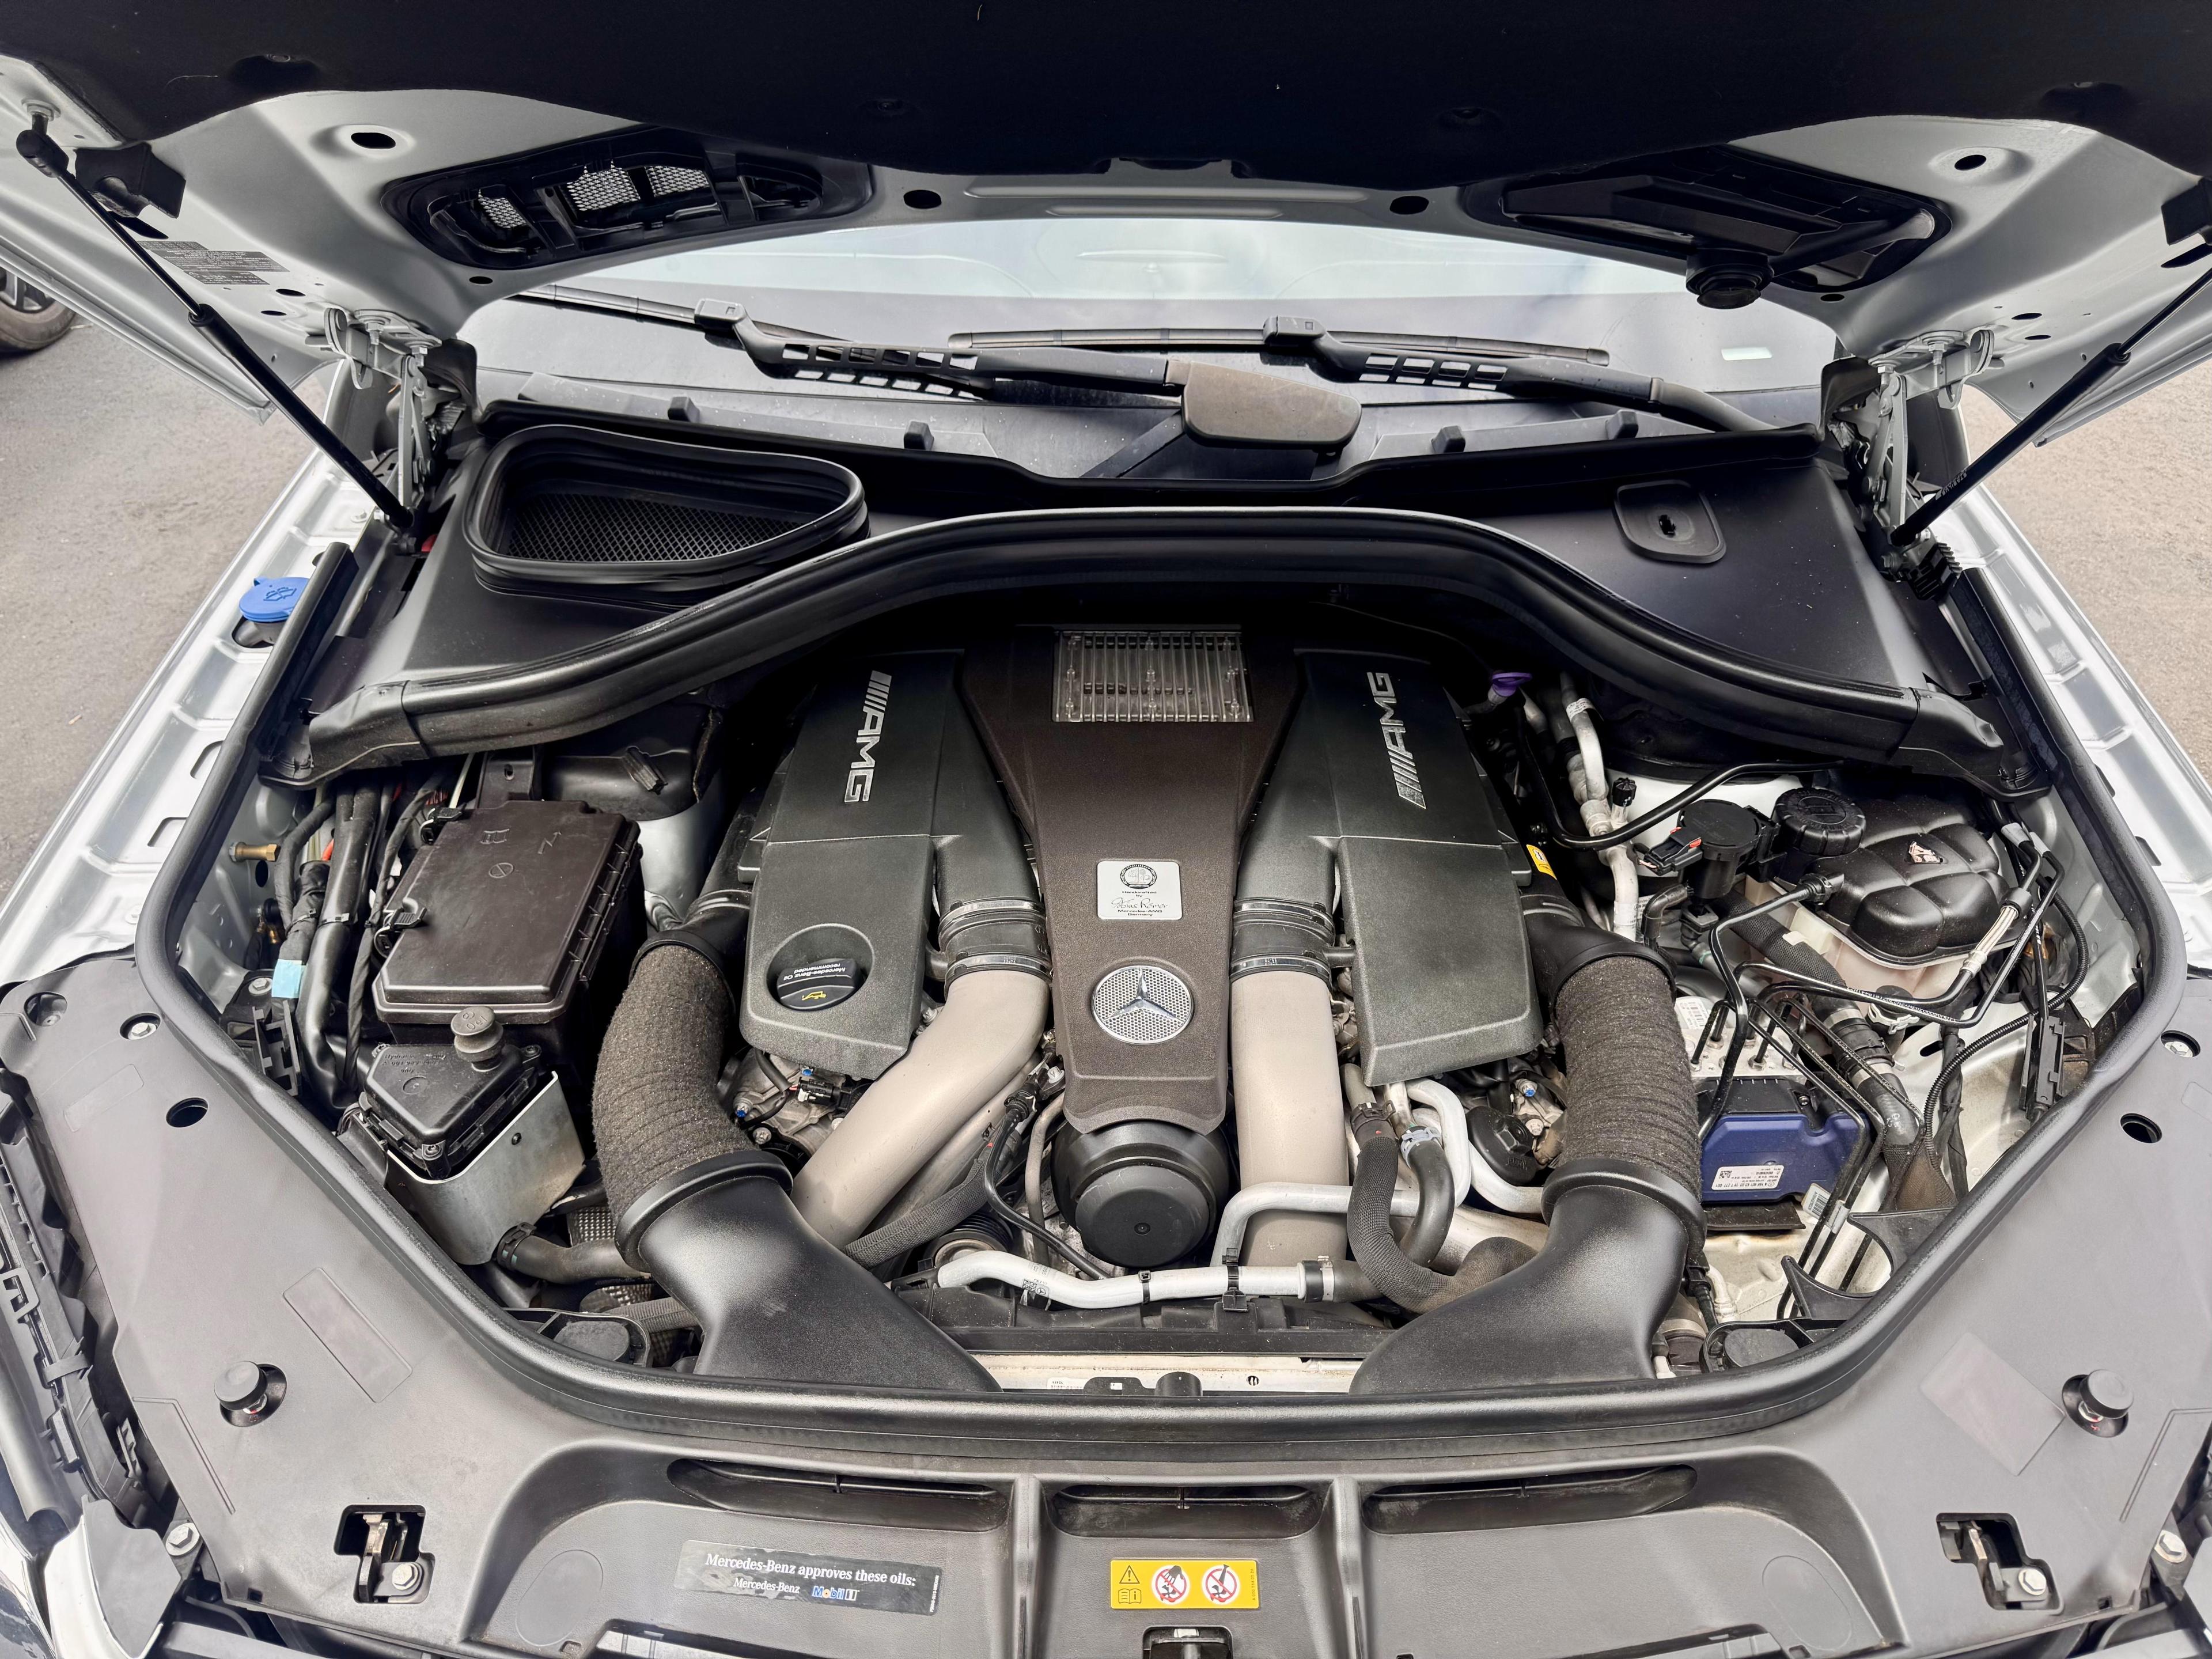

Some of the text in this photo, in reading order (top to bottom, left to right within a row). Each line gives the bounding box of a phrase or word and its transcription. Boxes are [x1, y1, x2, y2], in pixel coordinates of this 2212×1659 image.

[1366, 671, 1407, 752] AMG
[844, 706, 885, 803] AMG
[793, 963, 840, 974] recommended
[794, 967, 846, 978] Mercedes-Benz
[466, 1016, 487, 1030] Oel
[705, 1553, 916, 1586] Mercedes-Benz approves these oils:
[733, 1577, 800, 1593] Mercedes-Benz
[812, 1585, 844, 1600] Mobil
